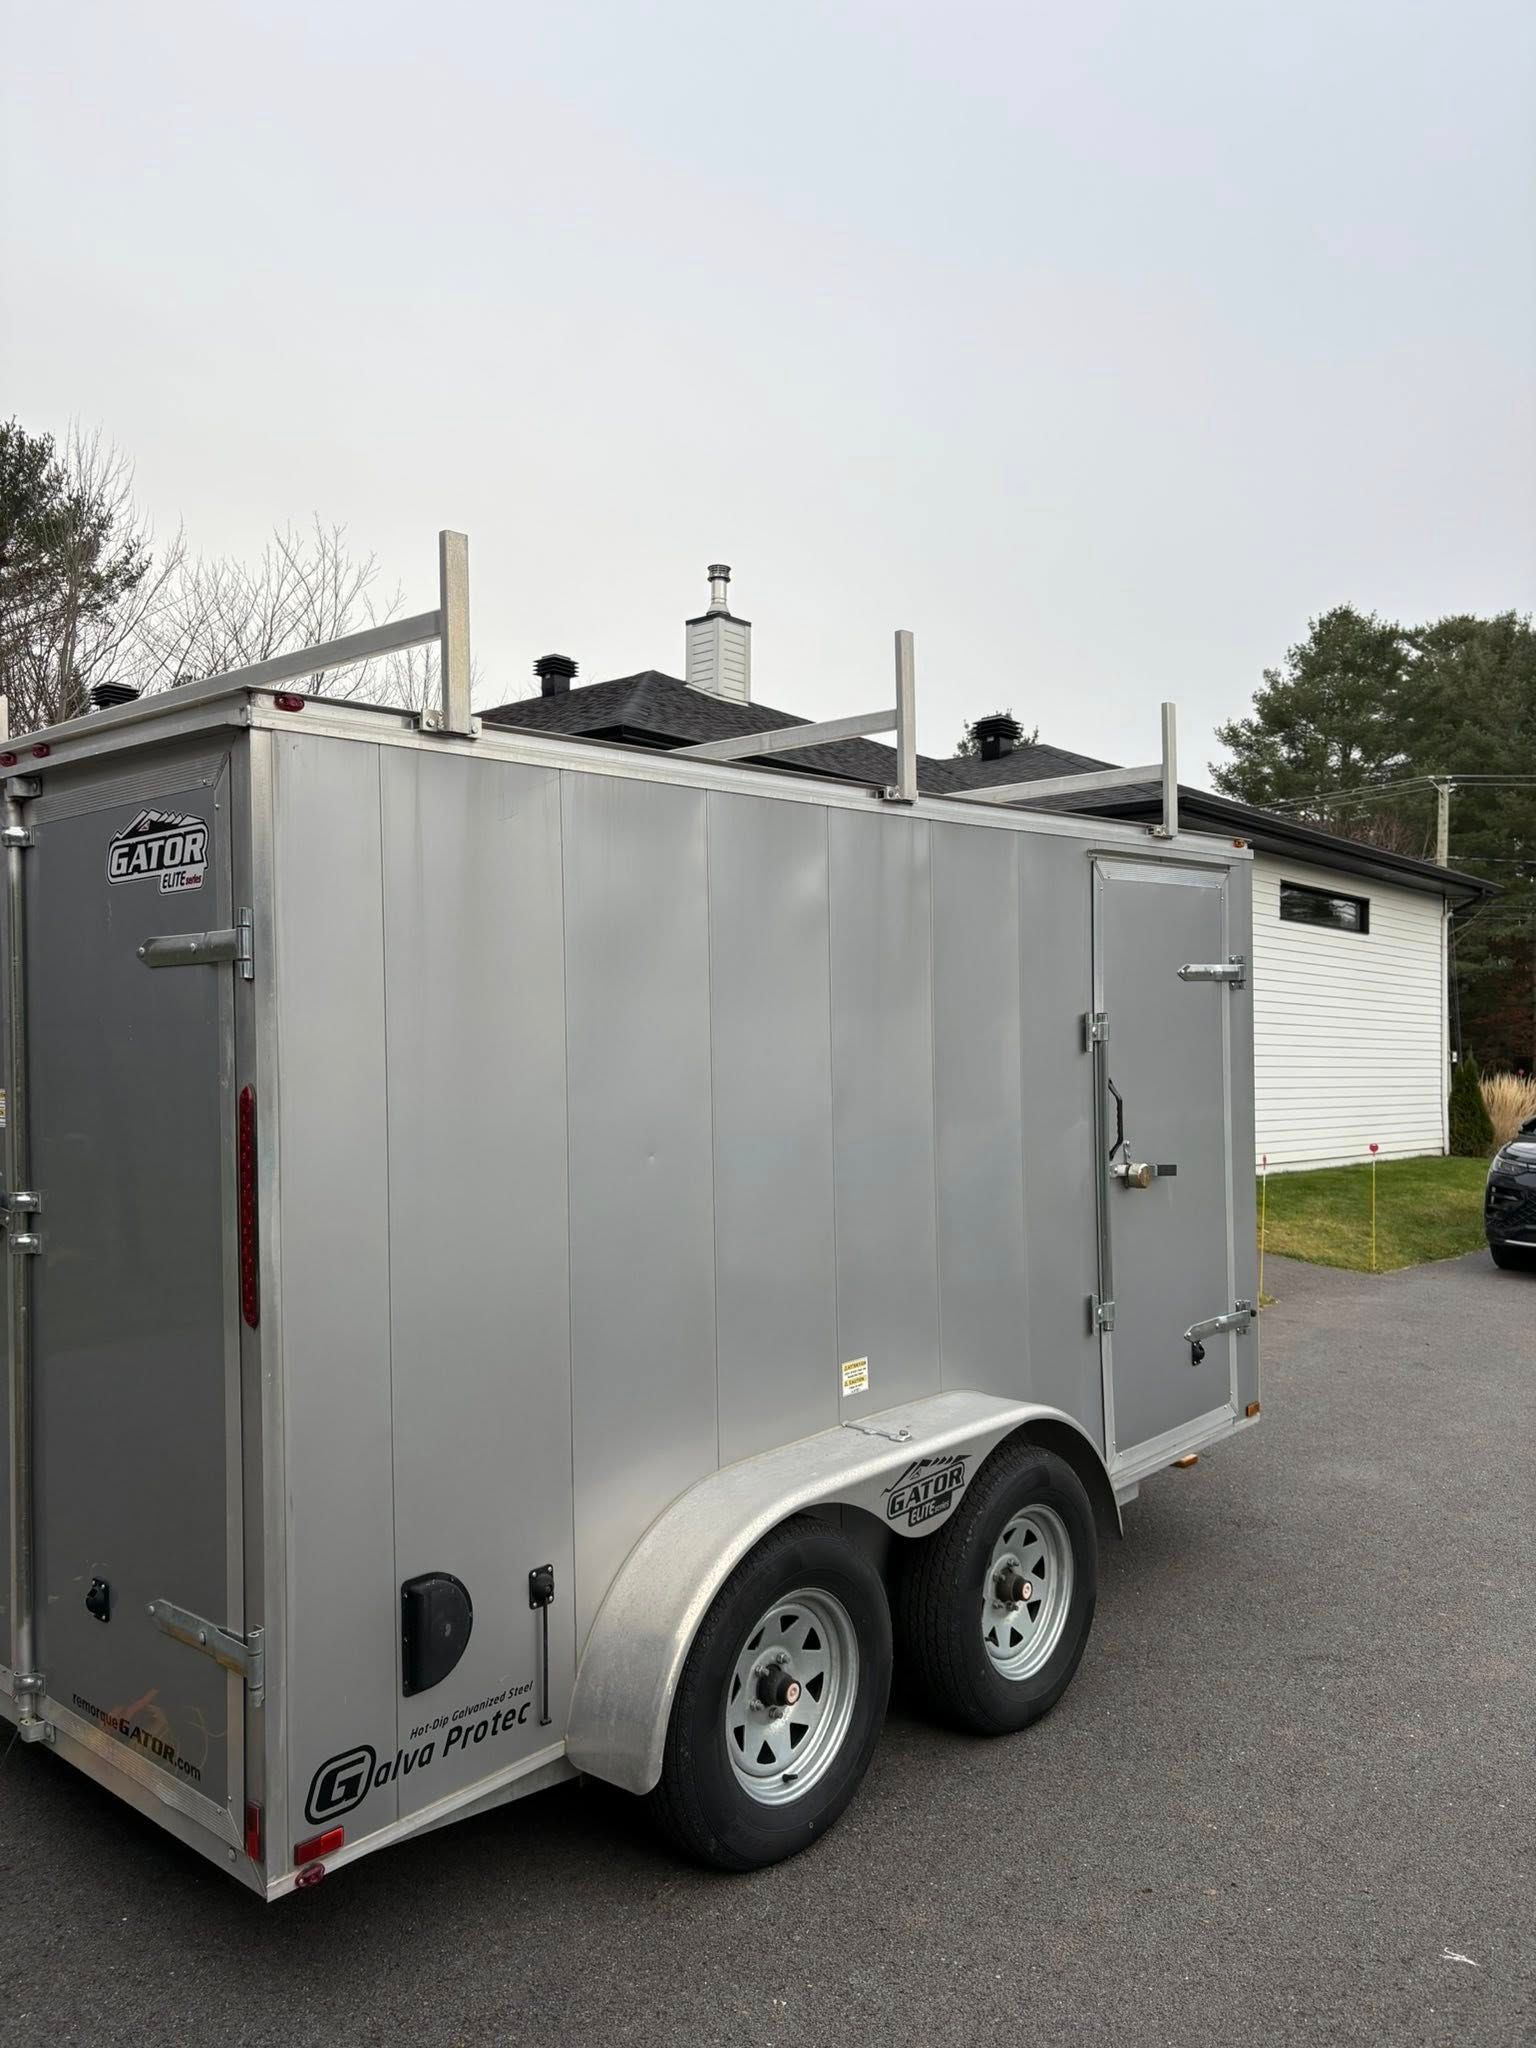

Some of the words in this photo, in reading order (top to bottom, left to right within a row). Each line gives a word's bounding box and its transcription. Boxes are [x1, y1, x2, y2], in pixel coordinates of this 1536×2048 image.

[110, 832, 205, 875] GATOR
[162, 870, 186, 889] ELITE
[890, 1466, 962, 1516] GATOR
[911, 1500, 936, 1524] ELITE
[410, 1715, 449, 1740] Hot-Dip
[452, 1690, 507, 1722] Galvanized
[508, 1680, 534, 1700] Steel
[312, 1742, 436, 1815] Galva
[442, 1701, 531, 1758] Protec
